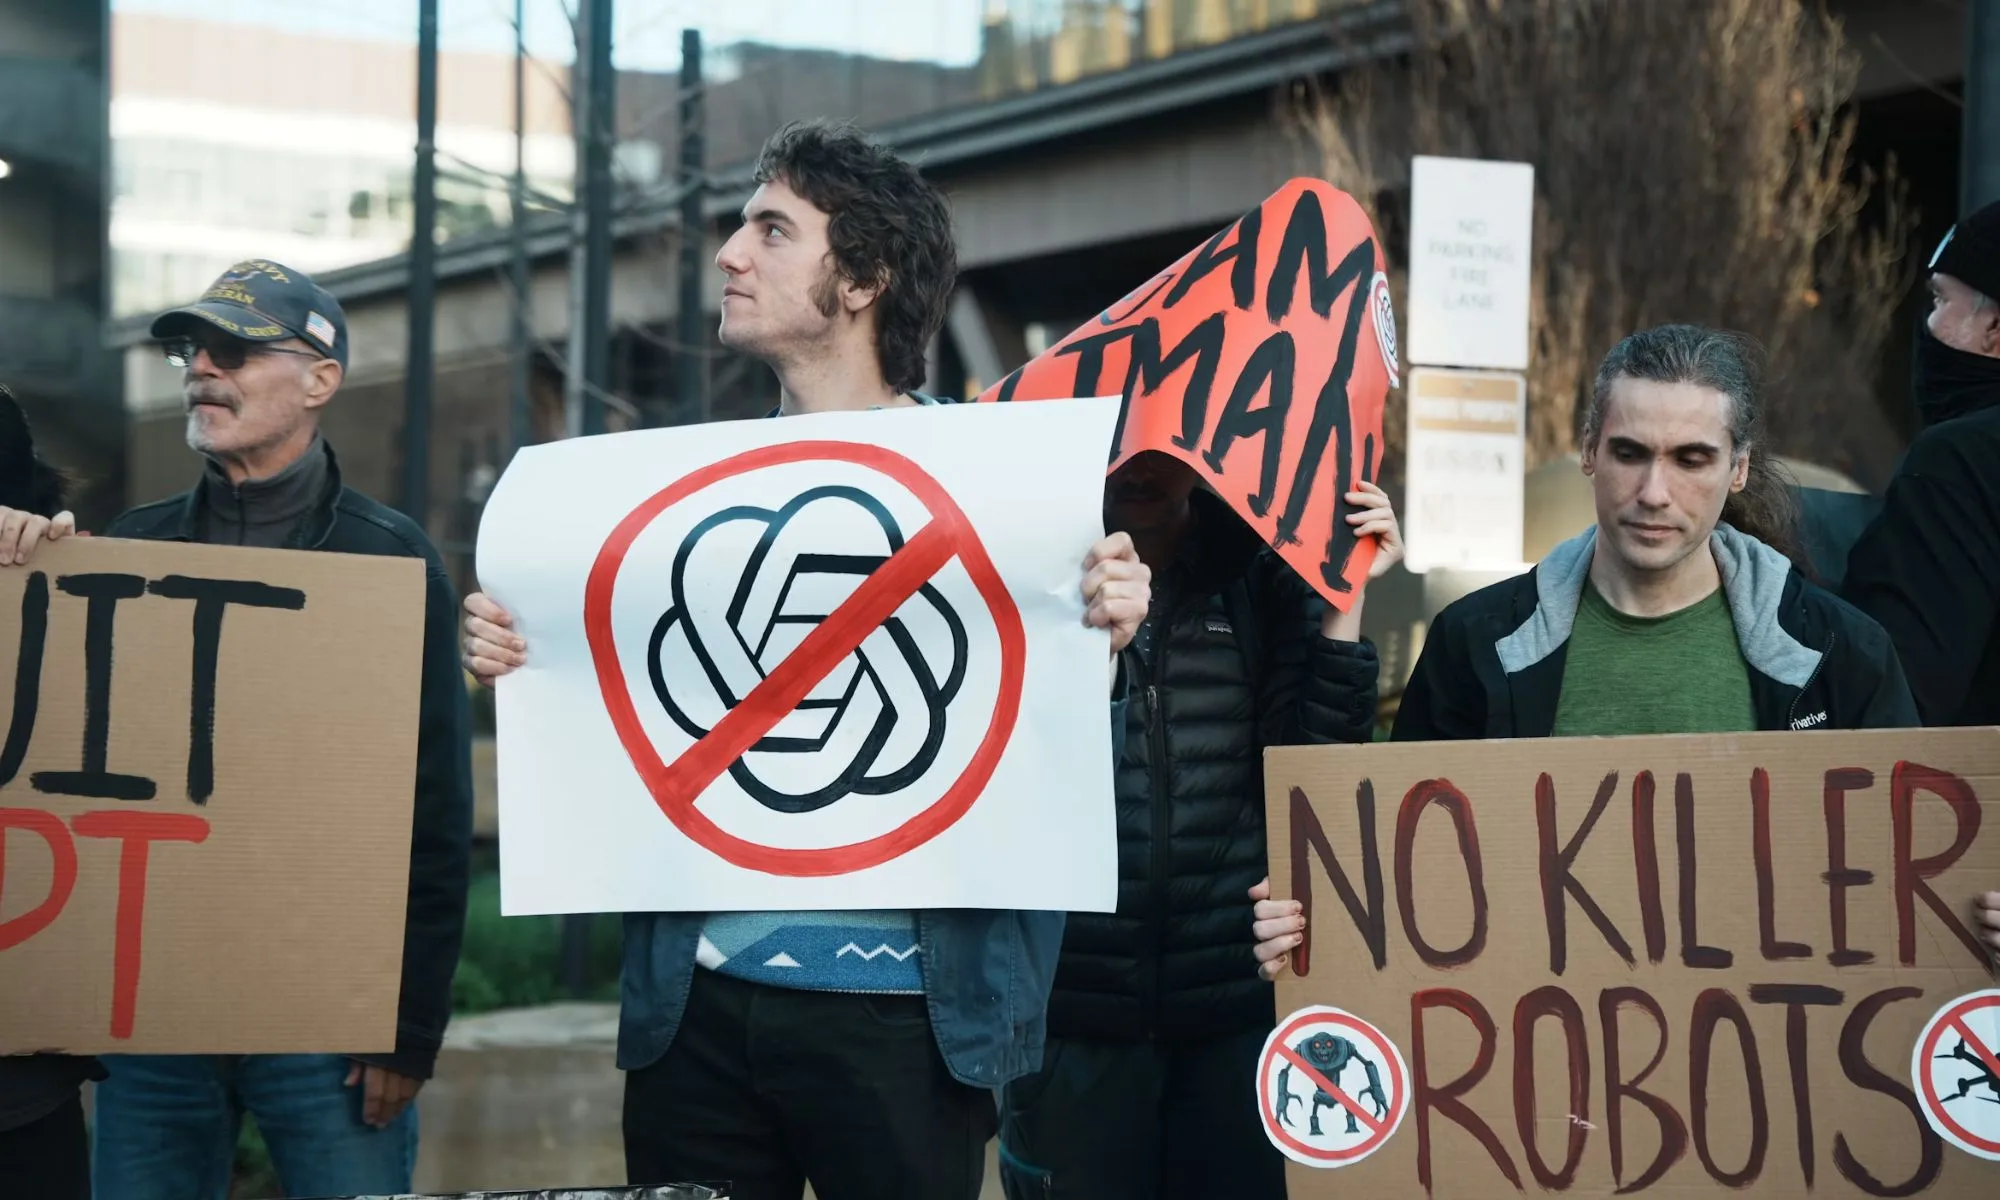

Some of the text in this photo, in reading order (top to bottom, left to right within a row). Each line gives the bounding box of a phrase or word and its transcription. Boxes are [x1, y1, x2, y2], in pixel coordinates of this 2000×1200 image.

[1101, 190, 1374, 385] AM
[967, 312, 1373, 592] TMAN
[1289, 760, 1996, 977] NO KILLER
[1411, 985, 1943, 1195] ROBOTS
